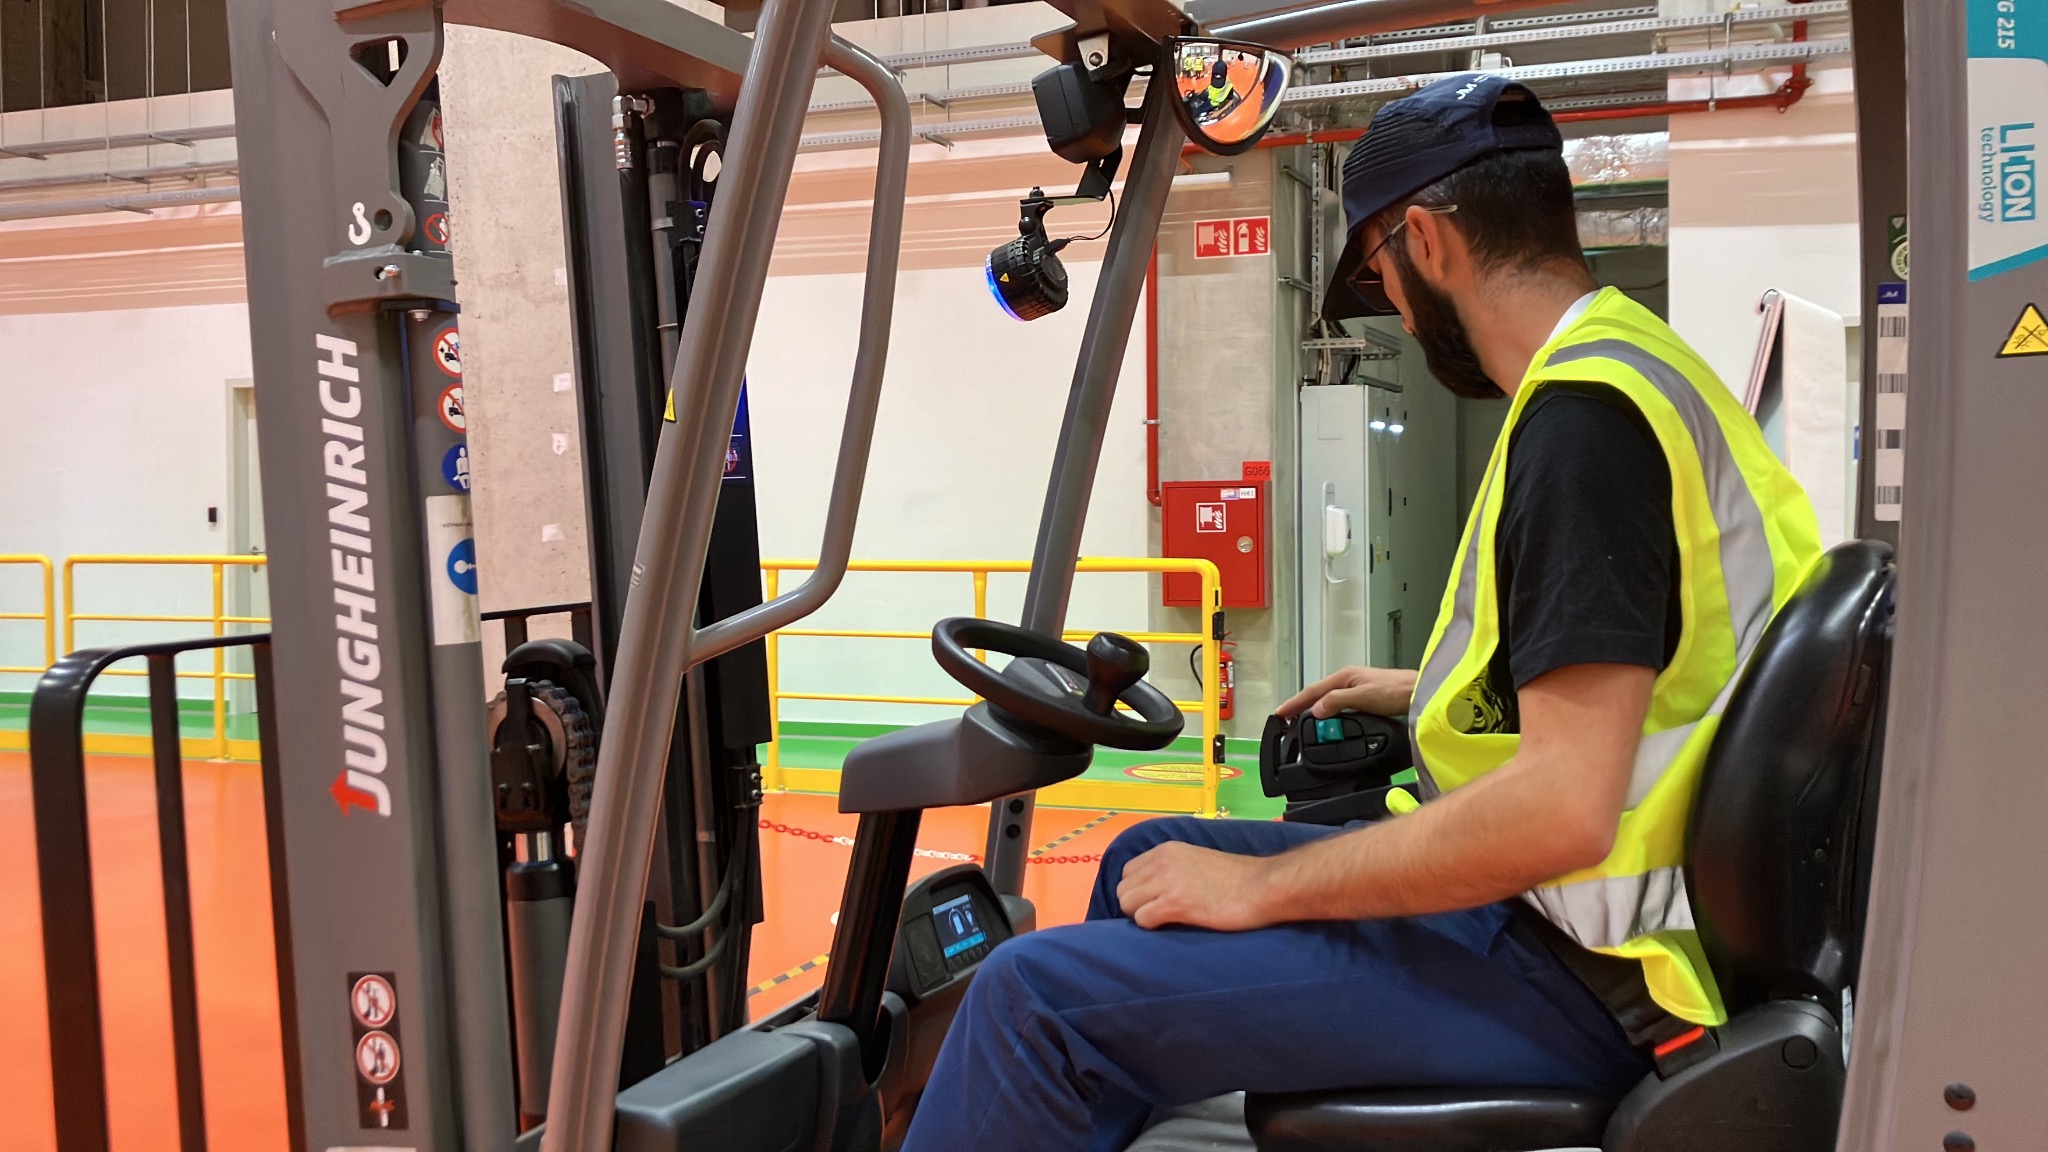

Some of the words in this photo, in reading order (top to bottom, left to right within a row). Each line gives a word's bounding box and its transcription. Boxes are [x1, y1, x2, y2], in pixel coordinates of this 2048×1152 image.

[1997, 0, 2015, 13] G
[1997, 17, 2016, 50] 215
[1978, 127, 1998, 223] technology
[315, 333, 392, 817] JUNGHEINRICH
